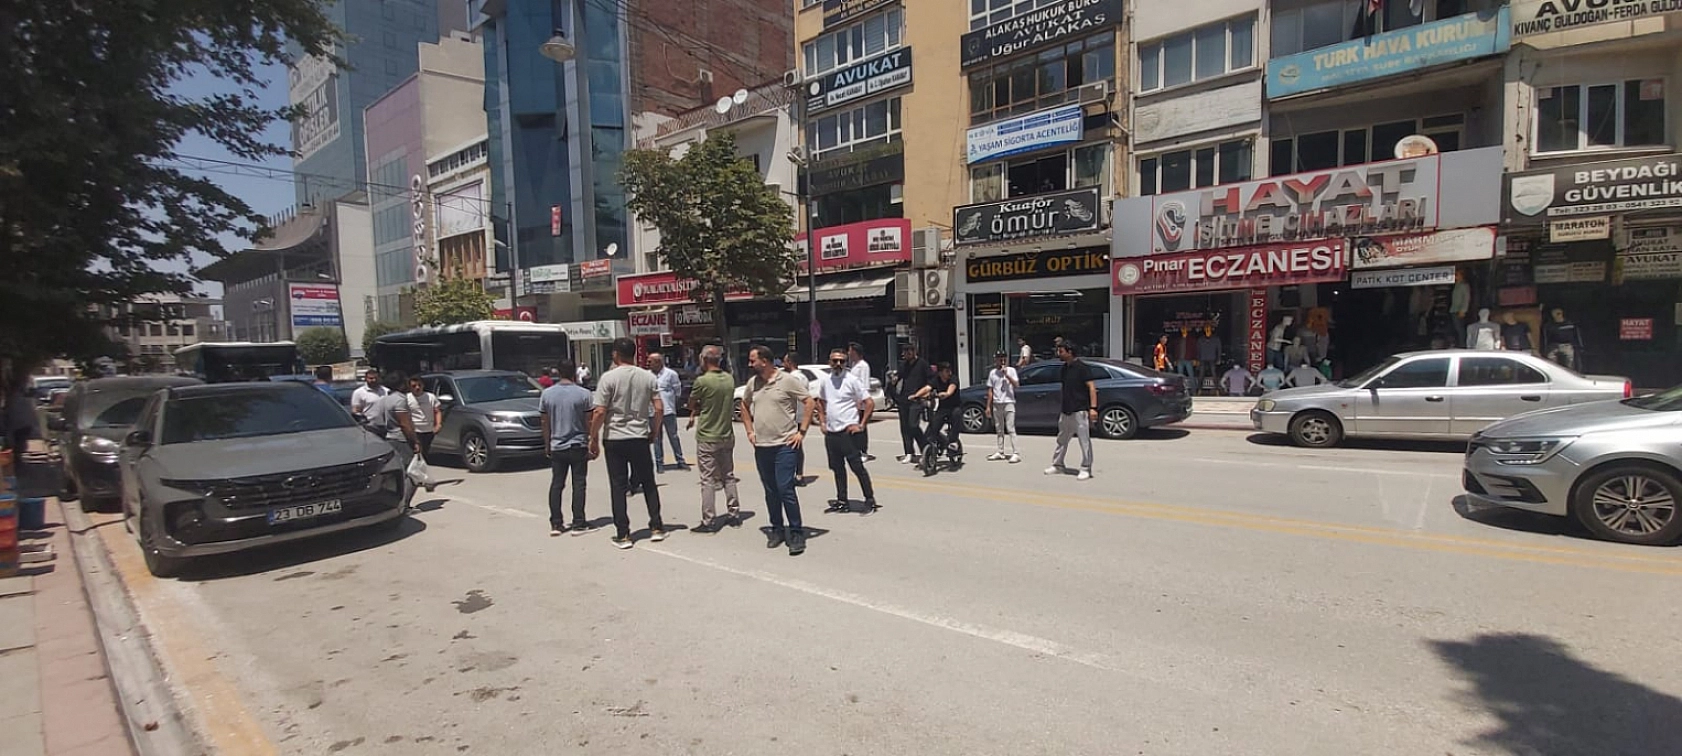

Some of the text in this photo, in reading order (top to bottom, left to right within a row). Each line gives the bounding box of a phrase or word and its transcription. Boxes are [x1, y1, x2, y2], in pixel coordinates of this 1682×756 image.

[1013, 9, 1085, 40] AVUKAT
[1026, 4, 1066, 26] HUKUK
[1514, 18, 1551, 36] KIVANÇ
[992, 38, 1030, 57] Uğur
[1363, 33, 1411, 61] HAVA
[834, 53, 902, 88] AVUKAT
[1004, 131, 1035, 147] SİGORTA
[1575, 161, 1677, 184] BEYDAĞI
[1200, 162, 1417, 216] HAYAT
[1564, 179, 1682, 202] GÜVENLİK
[1000, 198, 1054, 214] Kuaför
[1554, 218, 1605, 231] MARATON
[968, 250, 1105, 278] GÜRBÜZ OPTİK
[1188, 245, 1342, 281] ECZANESİ
[1627, 254, 1678, 263] AVUKAT
[1357, 273, 1382, 284] PATİK
[1386, 274, 1405, 283] KOT
[631, 313, 667, 326] ECZANE
[275, 509, 290, 520] 23
[318, 501, 340, 513] 744
